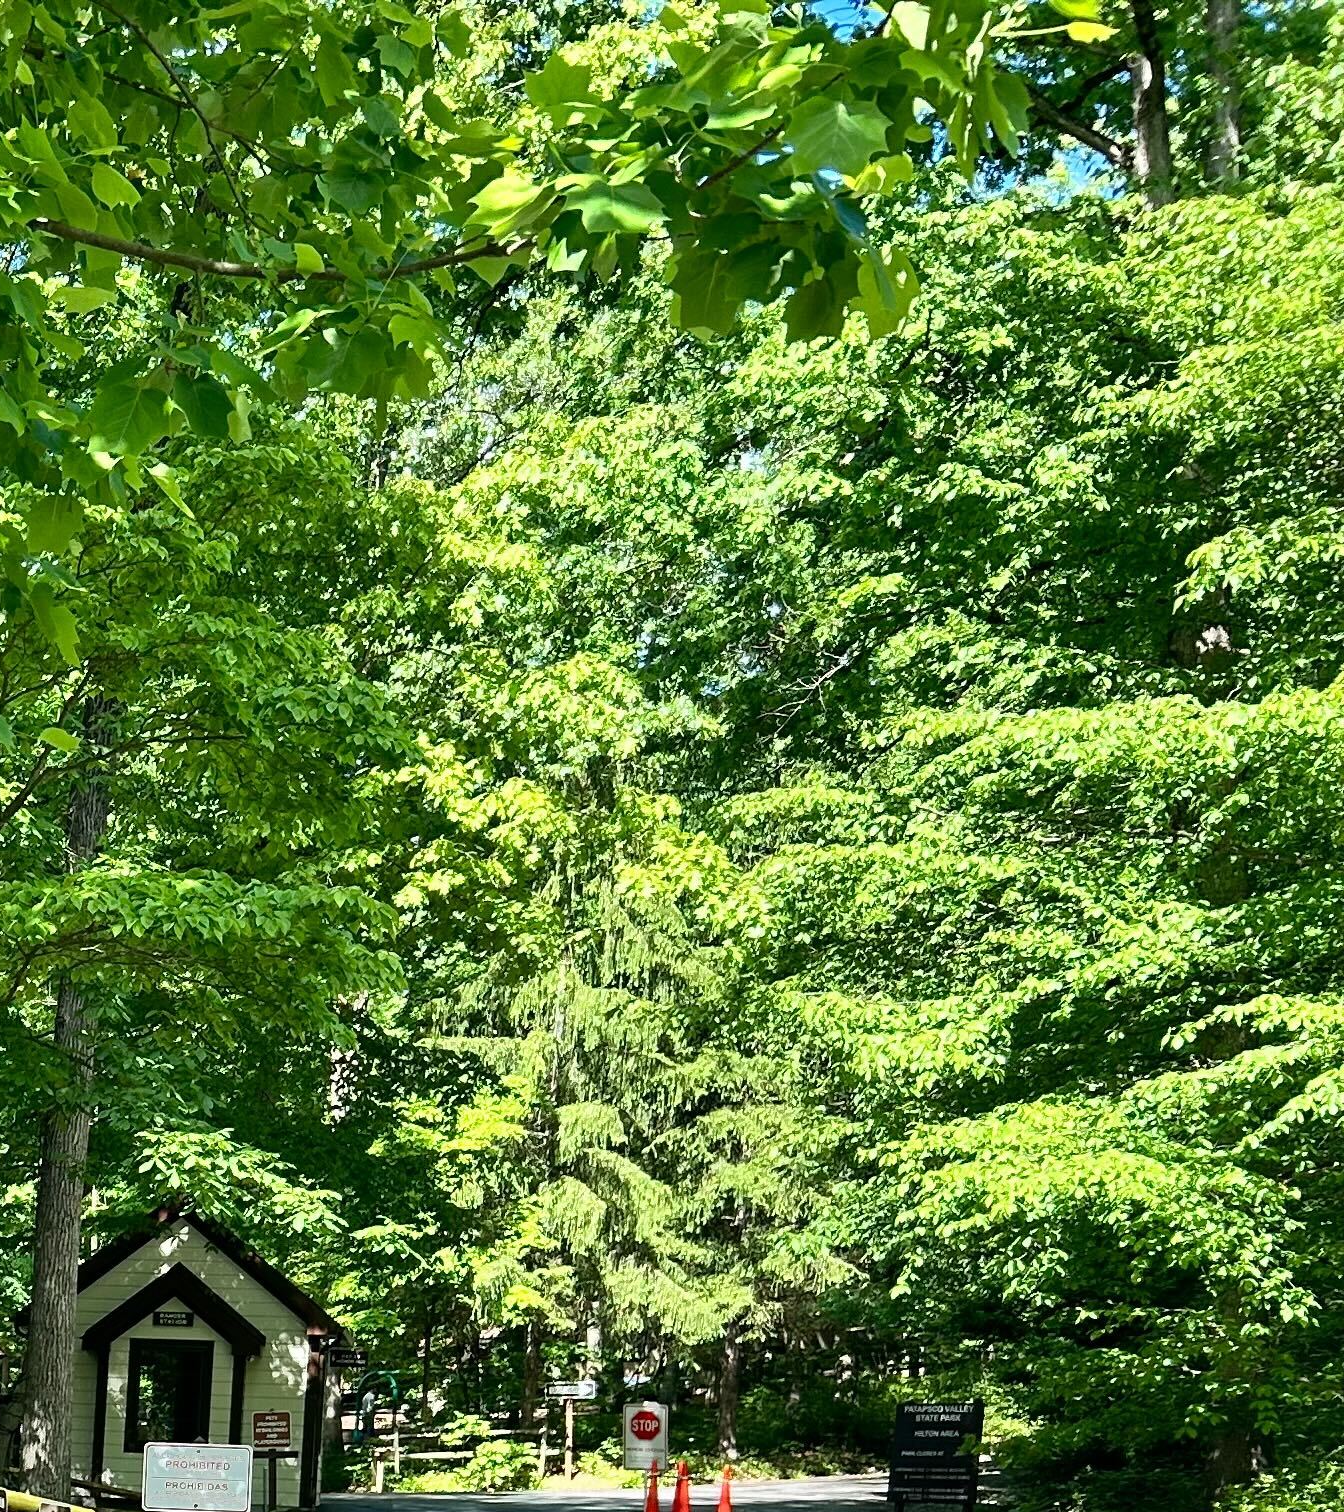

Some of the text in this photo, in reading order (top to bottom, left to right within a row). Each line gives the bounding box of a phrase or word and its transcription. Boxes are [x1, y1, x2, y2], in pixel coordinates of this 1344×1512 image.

[904, 1405, 974, 1413] PATAPSCO VALLEY
[915, 1414, 961, 1422] STATE PARK
[631, 1419, 659, 1433] STOP
[165, 1461, 231, 1471] PROHIBITED
